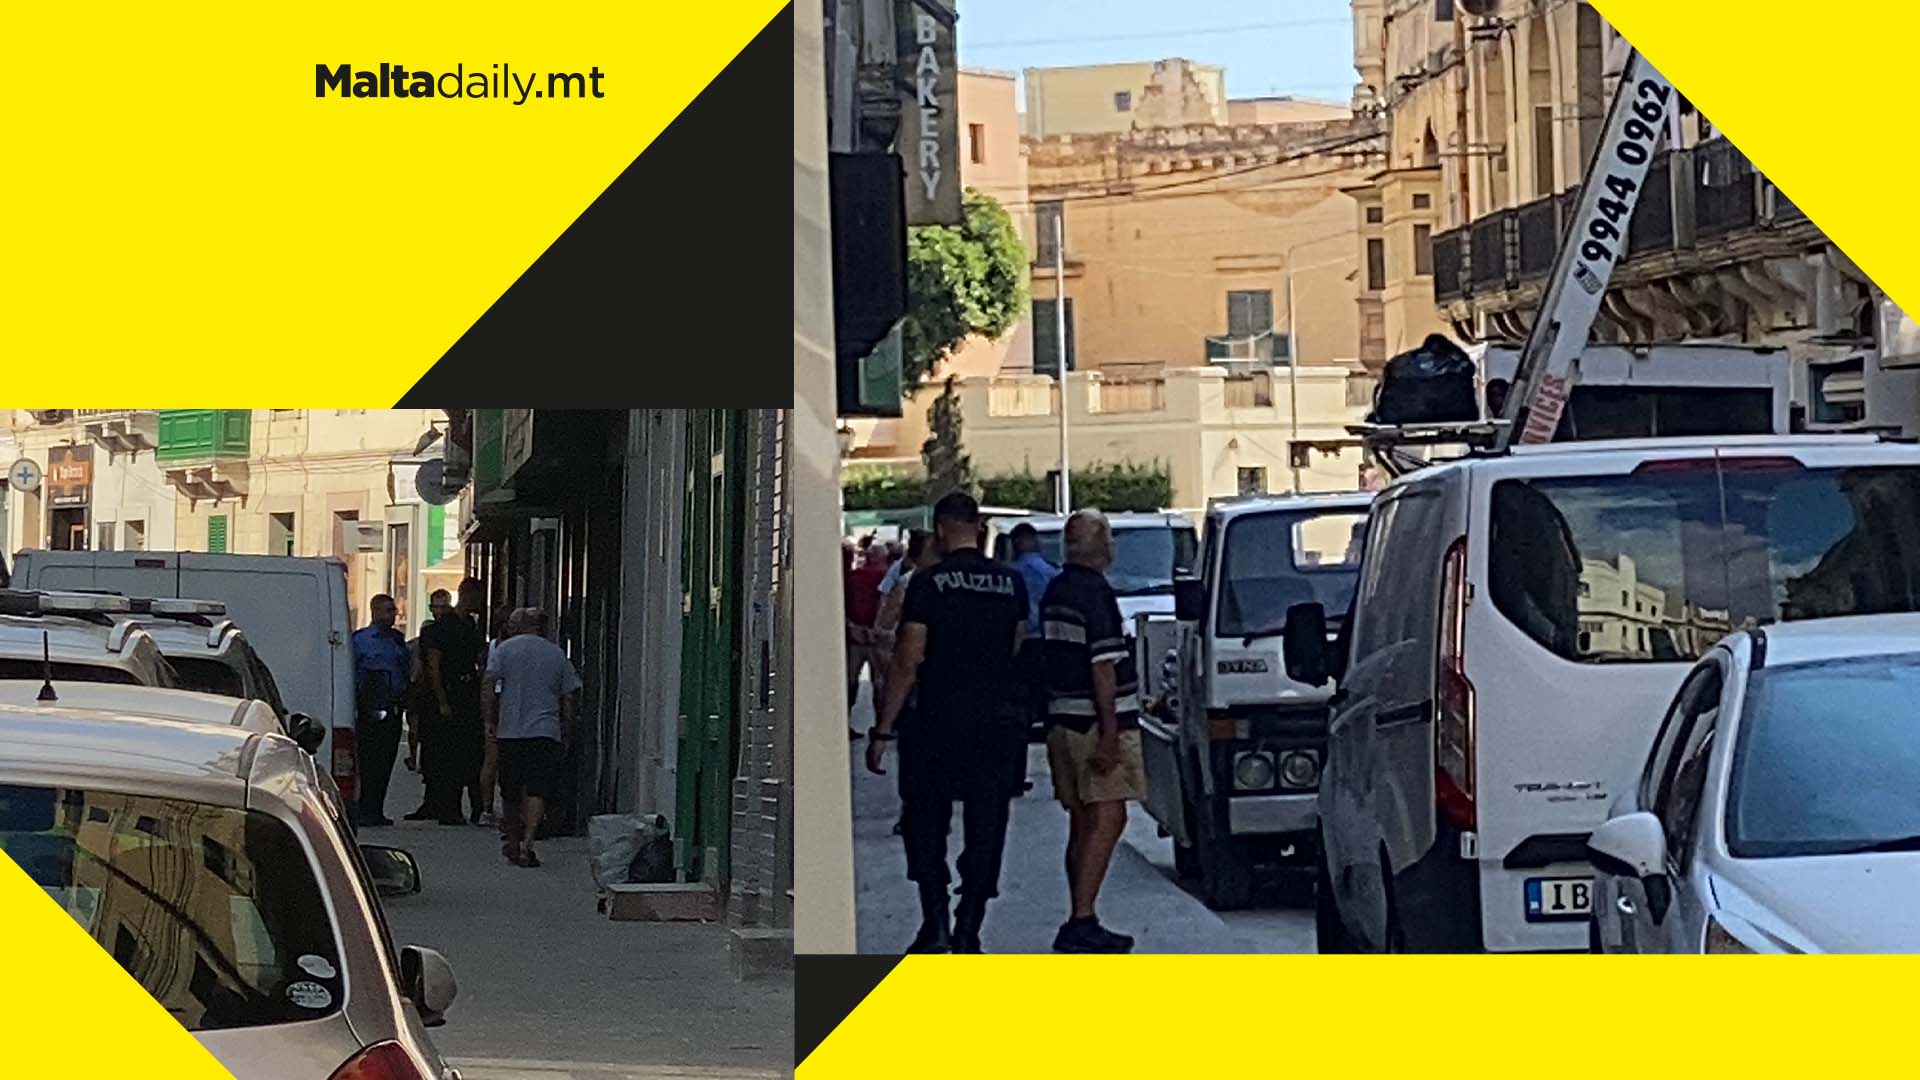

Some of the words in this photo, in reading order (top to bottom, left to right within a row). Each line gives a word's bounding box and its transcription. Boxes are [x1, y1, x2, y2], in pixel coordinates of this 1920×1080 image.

[916, 15, 941, 200] BAKERY
[1581, 174, 1637, 262] 9944
[1616, 79, 1671, 166] 0962
